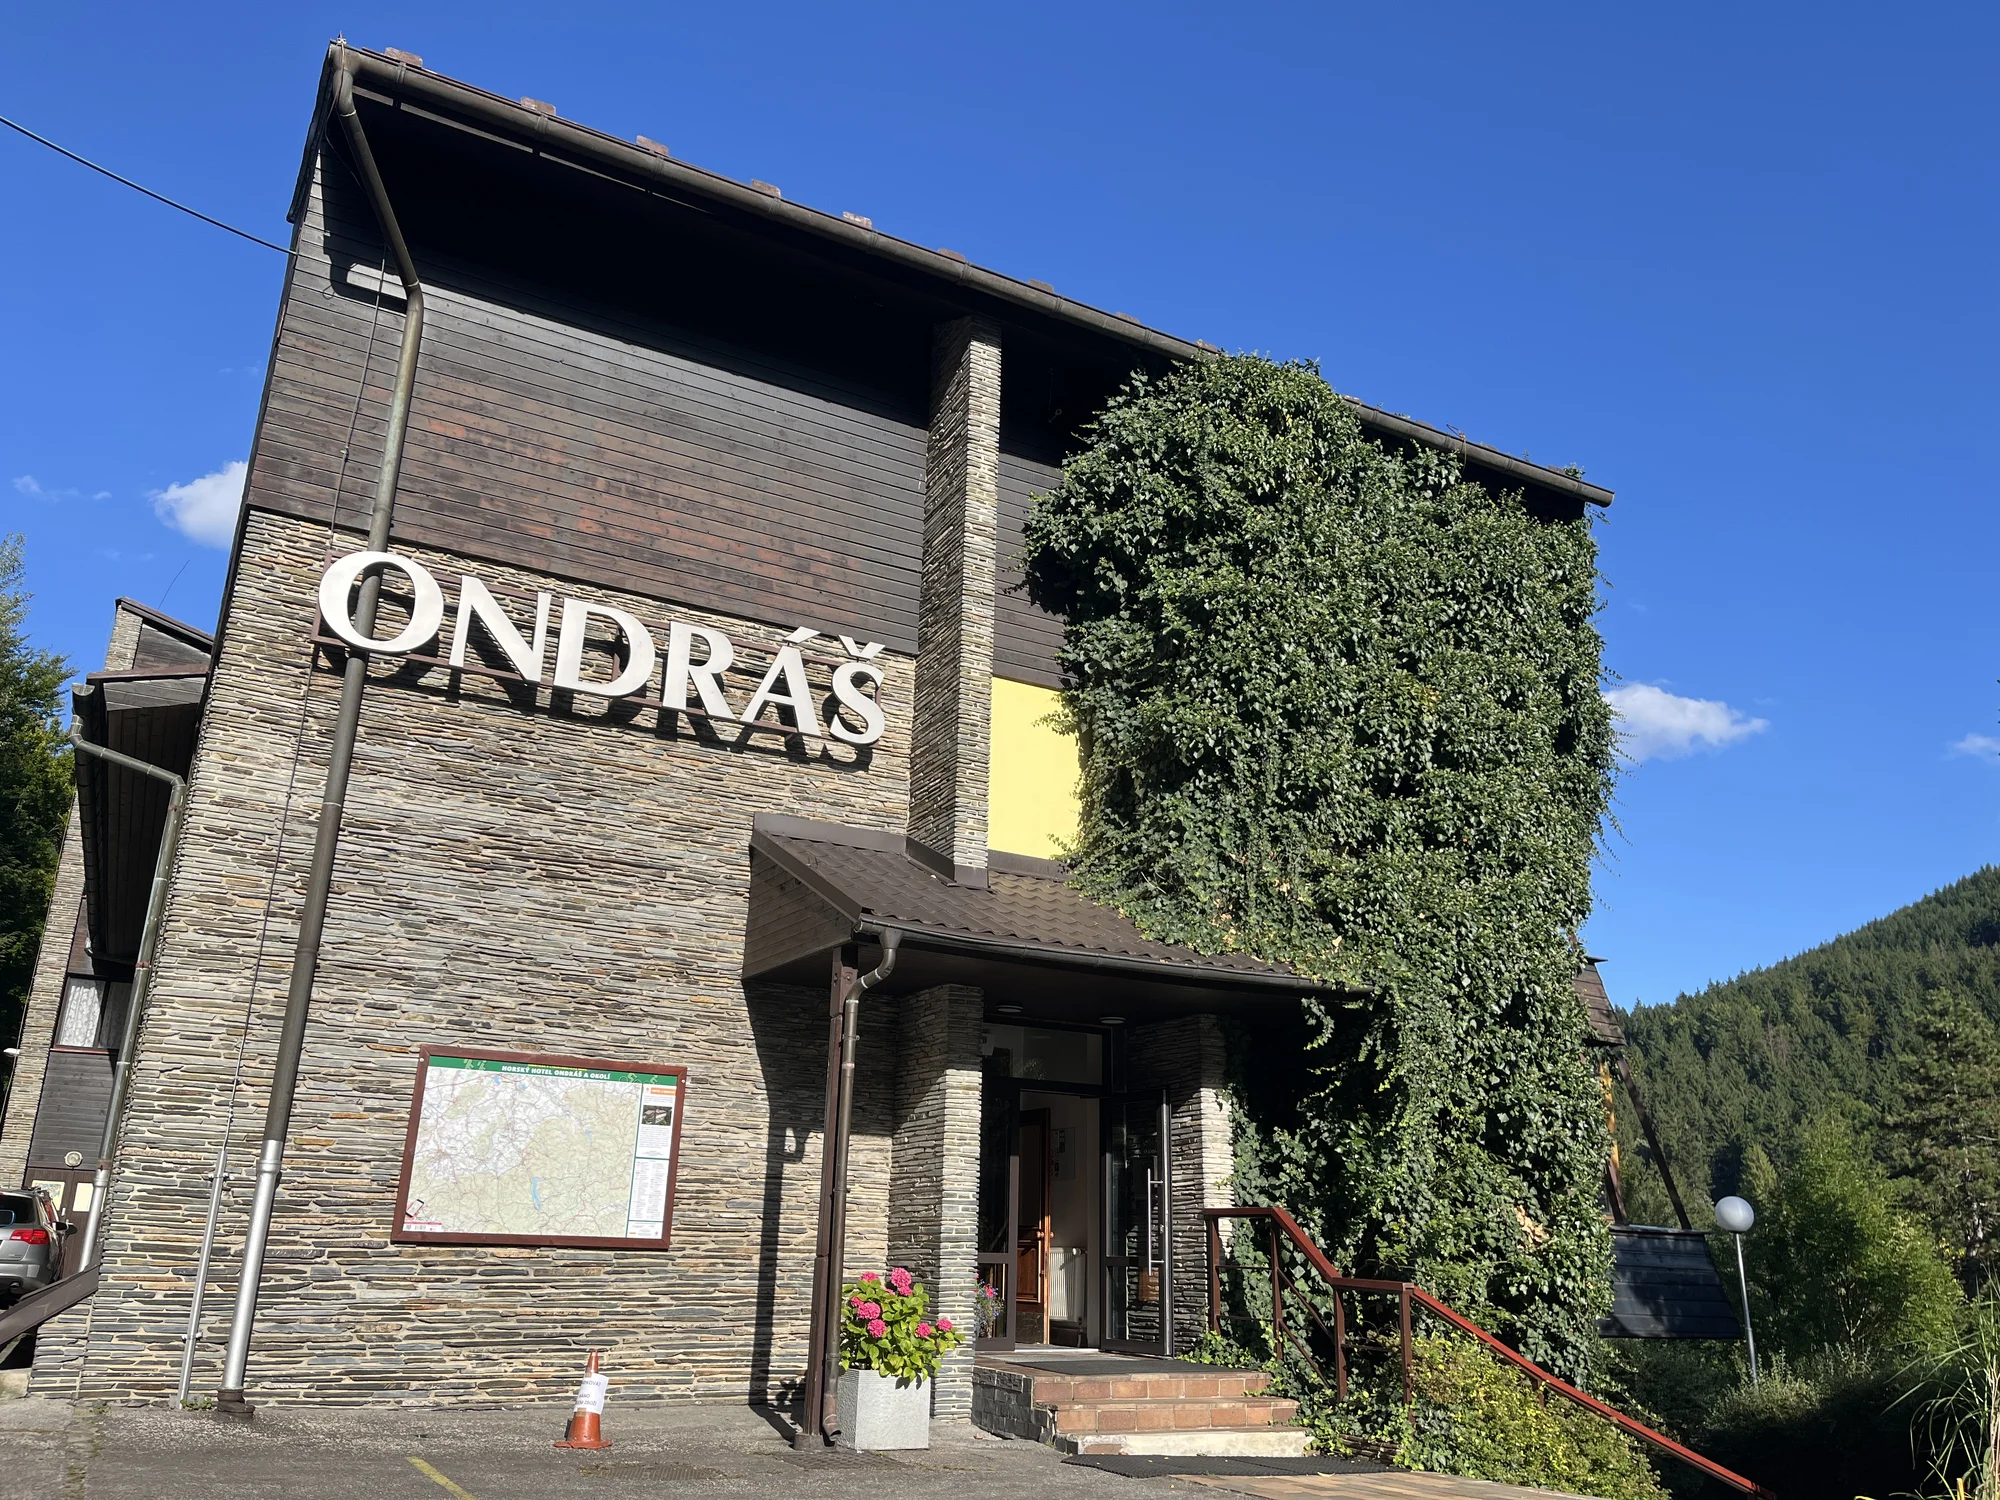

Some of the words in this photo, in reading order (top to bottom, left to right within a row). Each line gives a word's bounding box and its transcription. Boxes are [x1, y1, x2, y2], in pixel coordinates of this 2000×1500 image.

[318, 551, 885, 745] ONDRÁŠ
[502, 1065, 530, 1073] HORSKÝ
[531, 1067, 552, 1075] HOTEL
[554, 1069, 582, 1077] ONDRÁŠ
[590, 1072, 610, 1080] OKOLÍ
